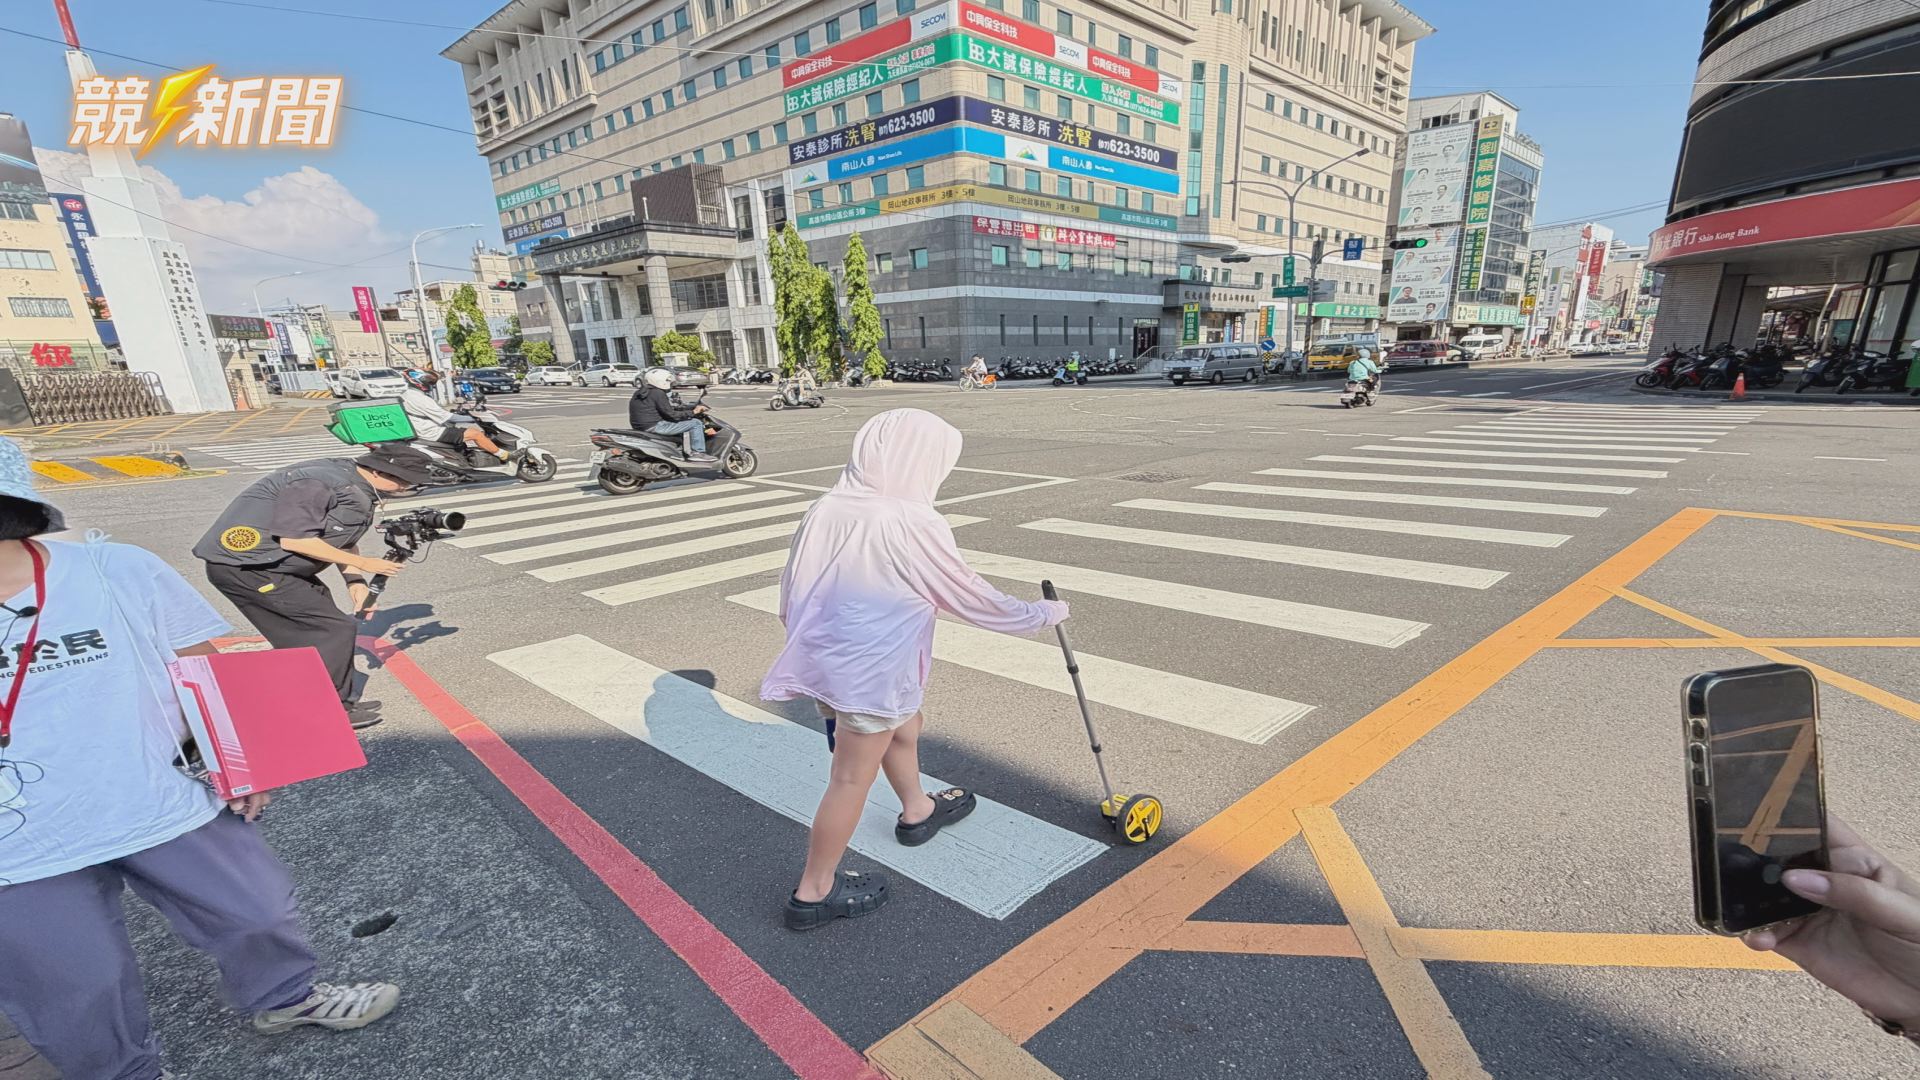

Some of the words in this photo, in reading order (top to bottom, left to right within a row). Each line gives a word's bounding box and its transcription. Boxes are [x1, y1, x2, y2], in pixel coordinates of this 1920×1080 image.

[920, 13, 946, 29] SECOM
[792, 132, 843, 161] 安泰診所
[845, 122, 876, 147] 洗腎
[879, 107, 935, 136] (07)623-3500
[991, 108, 1051, 137] 安泰診所
[1058, 123, 1092, 148] 洗腎
[1098, 138, 1160, 163] (07)623-3500
[1698, 235, 1714, 243] Shin
[1715, 231, 1736, 241] Kong
[1737, 226, 1760, 237] Bank
[361, 413, 390, 422] Uber
[365, 421, 394, 430] Eats
[25, 651, 109, 675] EDESTRIANS
